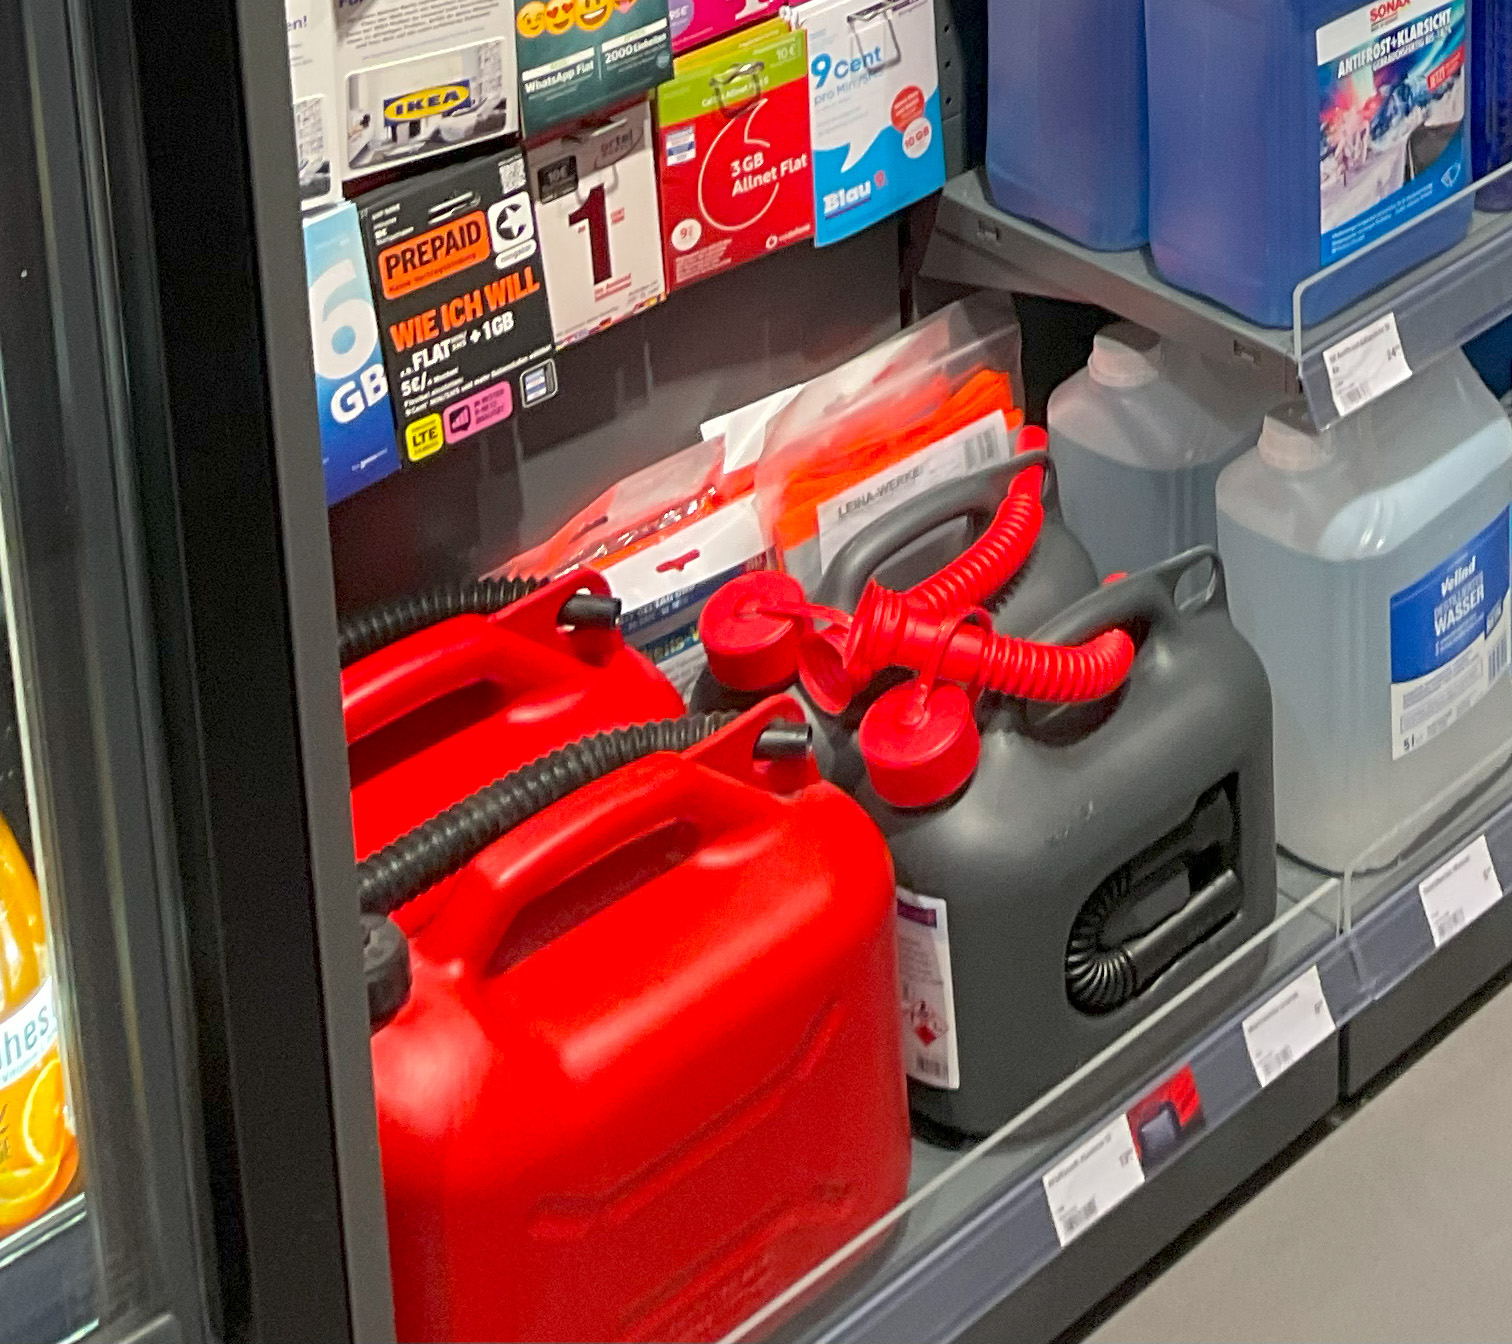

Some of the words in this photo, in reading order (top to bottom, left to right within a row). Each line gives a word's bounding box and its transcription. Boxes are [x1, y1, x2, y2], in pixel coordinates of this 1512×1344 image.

[604, 45, 632, 65] 2000
[1336, 6, 1453, 80] ANTIFROST+KLARSICHT
[524, 66, 575, 94] WhatsApp
[576, 59, 595, 77] Flat
[394, 88, 462, 117] IKEA
[731, 166, 778, 198] Allnet
[779, 153, 808, 178] Flat
[822, 180, 873, 214] Blau
[383, 217, 482, 280] PREPAID
[307, 259, 379, 381] 6
[389, 309, 440, 353] WIE
[441, 289, 484, 332] ICH
[484, 266, 541, 312] WILL
[330, 363, 389, 424] GB
[412, 426, 439, 448] LTE
[1441, 555, 1477, 597] Velind
[1434, 582, 1485, 638] WASSER
